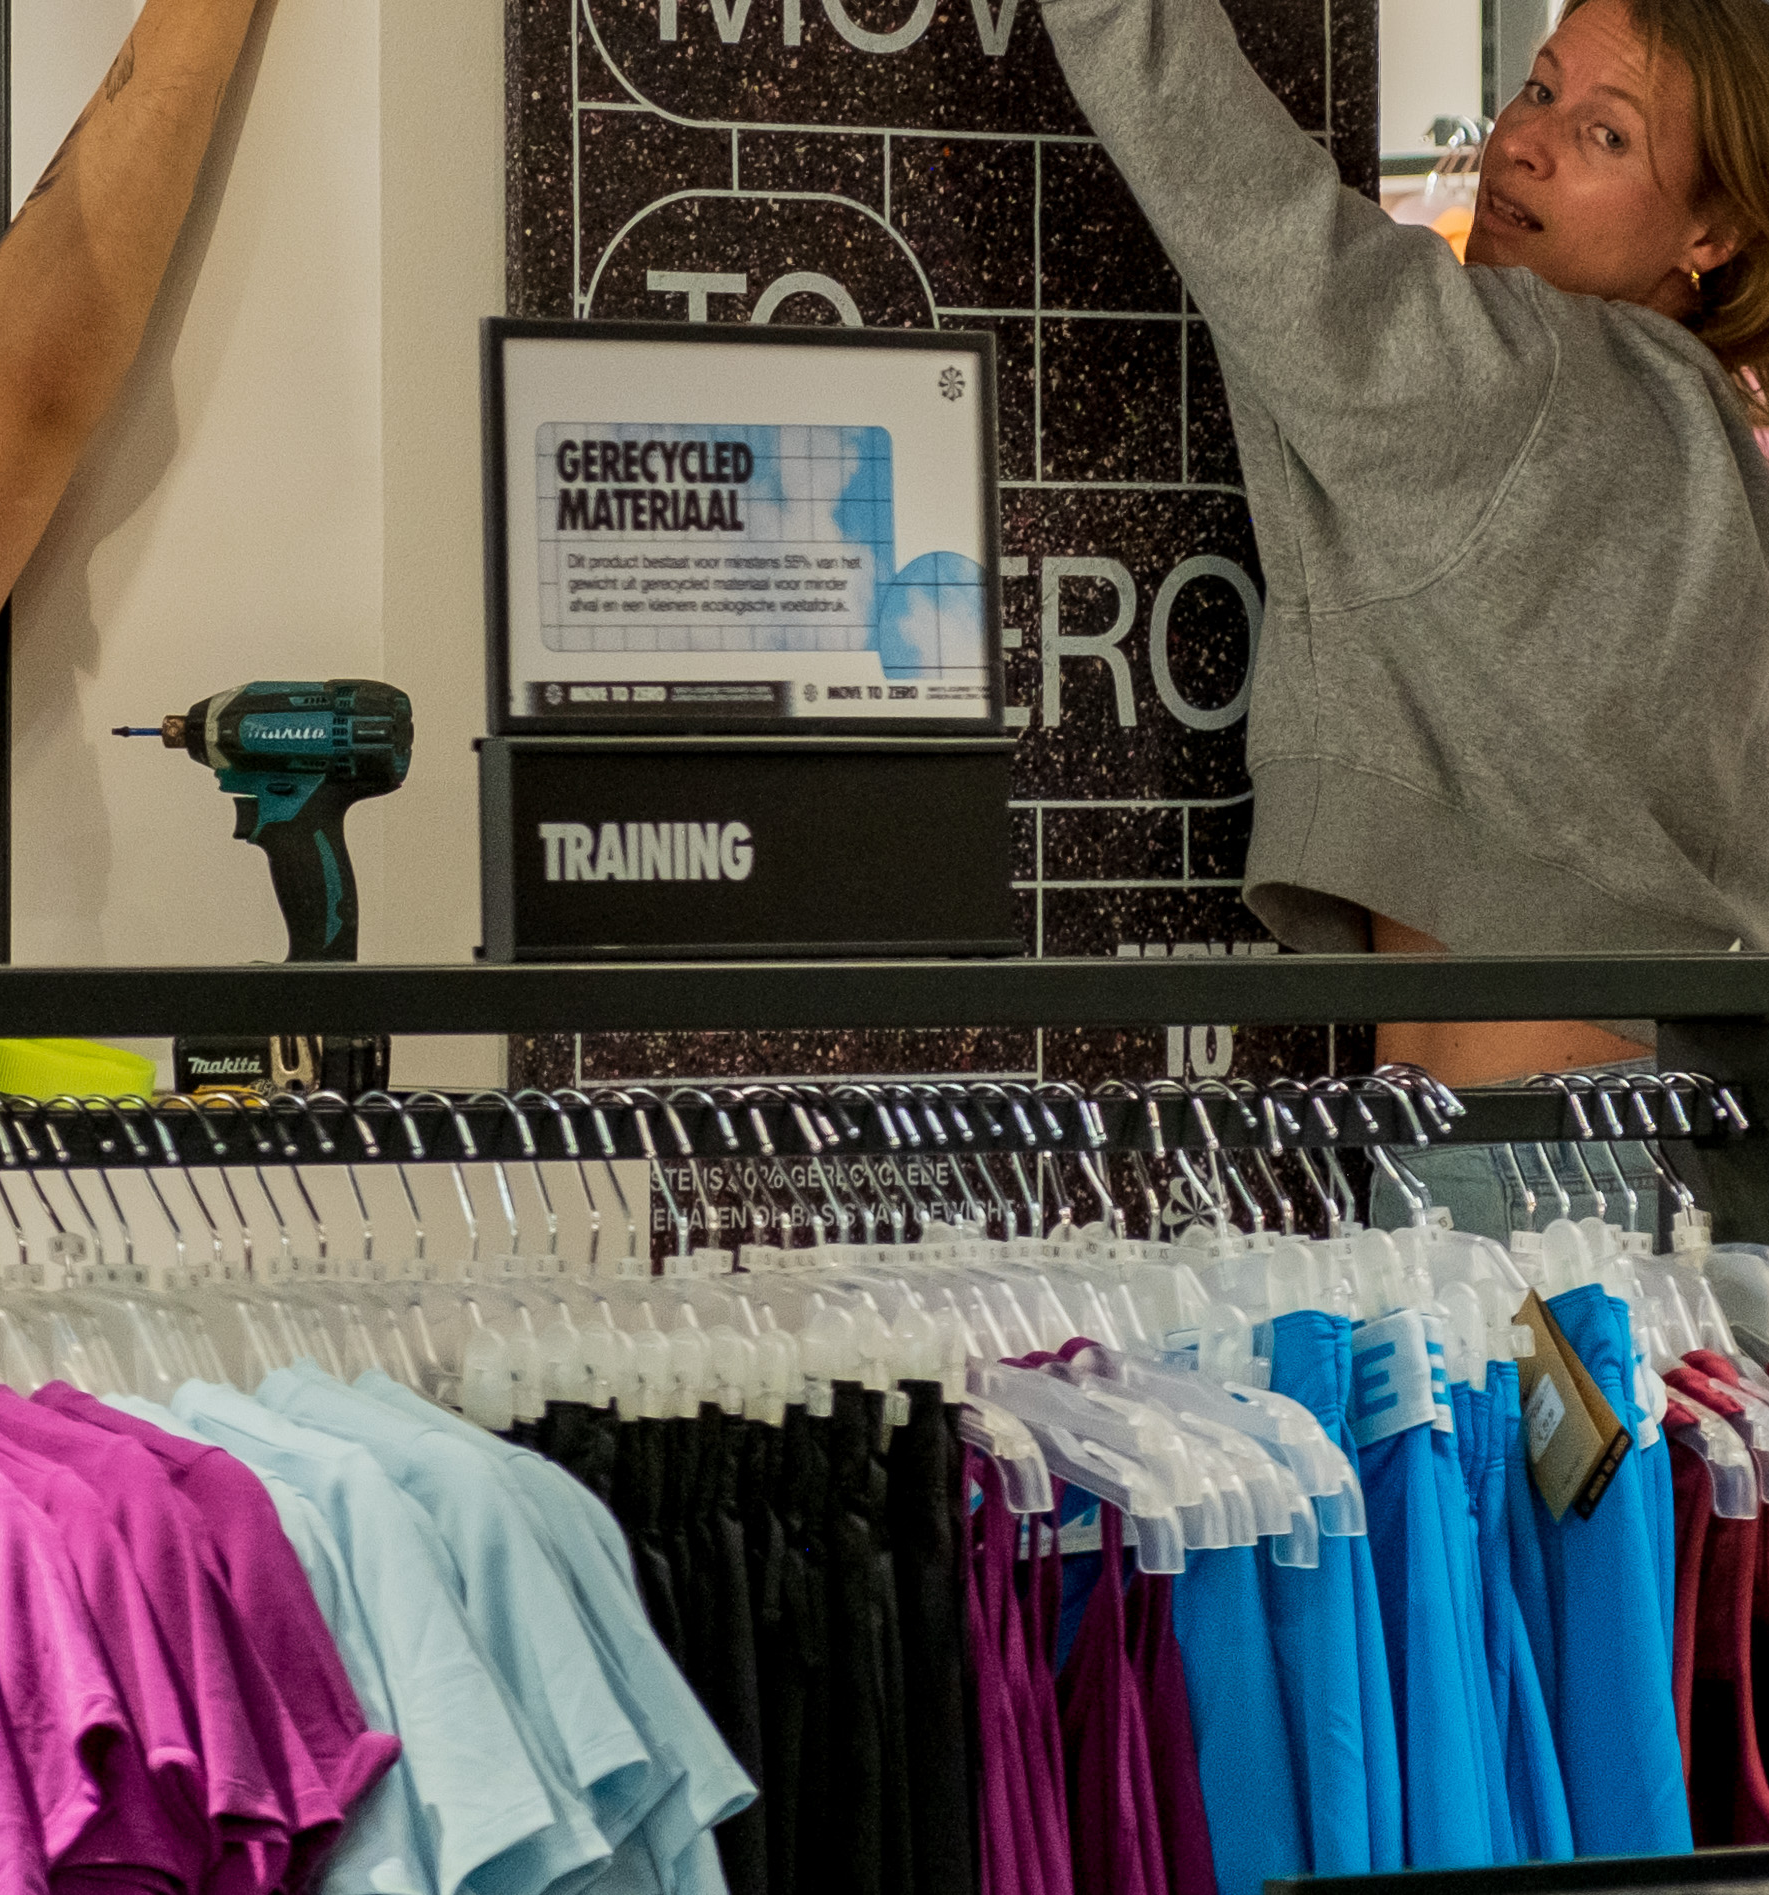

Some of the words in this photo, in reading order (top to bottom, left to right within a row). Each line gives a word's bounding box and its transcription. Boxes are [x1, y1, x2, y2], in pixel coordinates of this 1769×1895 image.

[556, 440, 754, 483] GERECYCLED
[557, 489, 744, 531] MATERIAAL
[589, 555, 638, 571] product
[643, 555, 689, 569] bestaat
[694, 558, 719, 569] voor
[569, 576, 617, 593] gewicht
[641, 576, 709, 593] gerecycled
[713, 577, 770, 590] materiaal
[774, 578, 800, 590] voor
[701, 598, 776, 616] ecologische
[999, 554, 1265, 731] RO
[539, 821, 754, 882] TRAINING
[651, 1166, 723, 1191] STENS
[791, 1161, 949, 1188] GERECCLEDE
[1351, 1340, 1396, 1421] E
